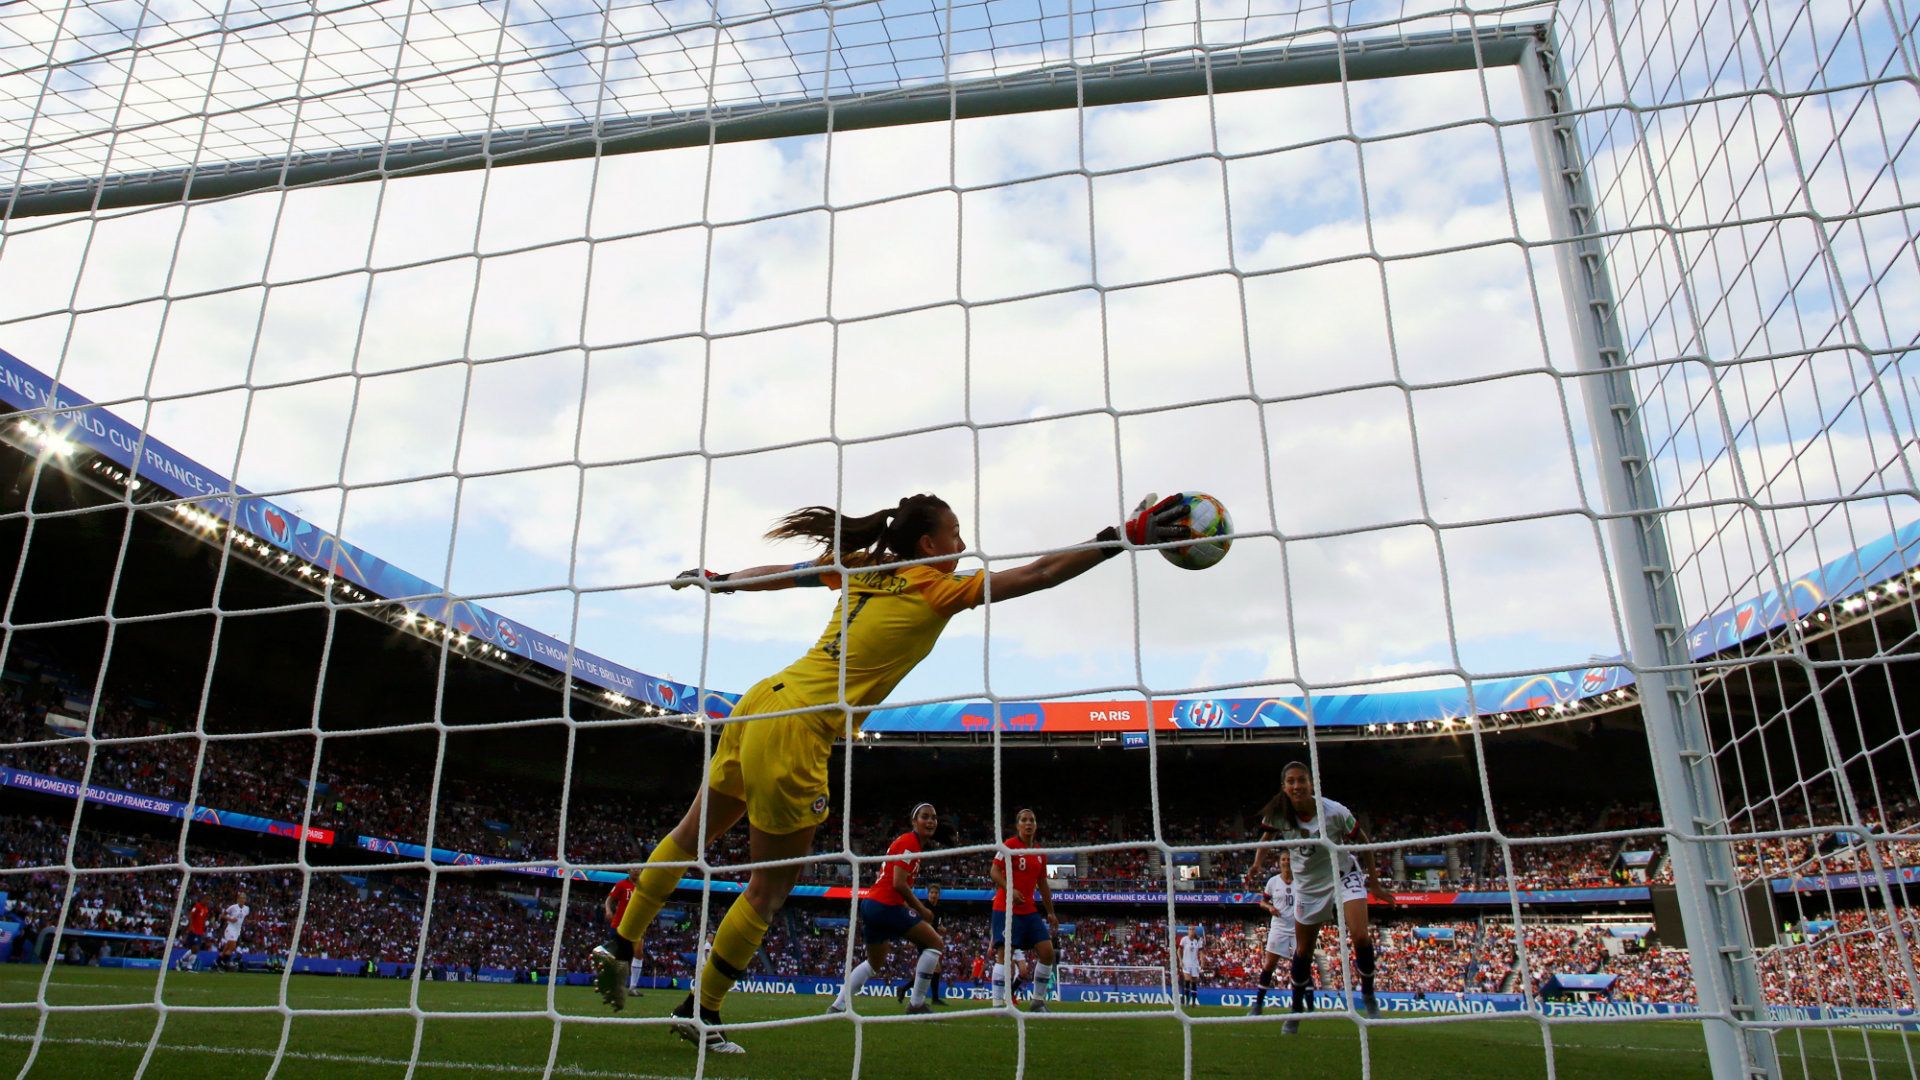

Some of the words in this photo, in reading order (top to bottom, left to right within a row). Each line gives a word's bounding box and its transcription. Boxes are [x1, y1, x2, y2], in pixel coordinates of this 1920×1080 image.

[145, 447, 205, 494] FRANCE
[533, 639, 546, 654] LE
[545, 645, 586, 670] MOMNT
[586, 661, 600, 676] DE
[600, 666, 634, 689] BRILLER
[1090, 710, 1131, 721] PARIS
[14, 774, 33, 787] FIFA
[34, 777, 75, 794] WOMEN'S
[106, 792, 123, 804] CUP
[123, 795, 153, 810] FRANCE
[153, 801, 171, 813] 2019
[306, 830, 324, 840] PARIS
[1019, 857, 1026, 870] 8
[1341, 873, 1362, 889] 23
[1076, 893, 1101, 901] MONDE
[1137, 893, 1147, 901] DE
[1175, 894, 1203, 902] FRANCE
[1285, 895, 1294, 906] 10
